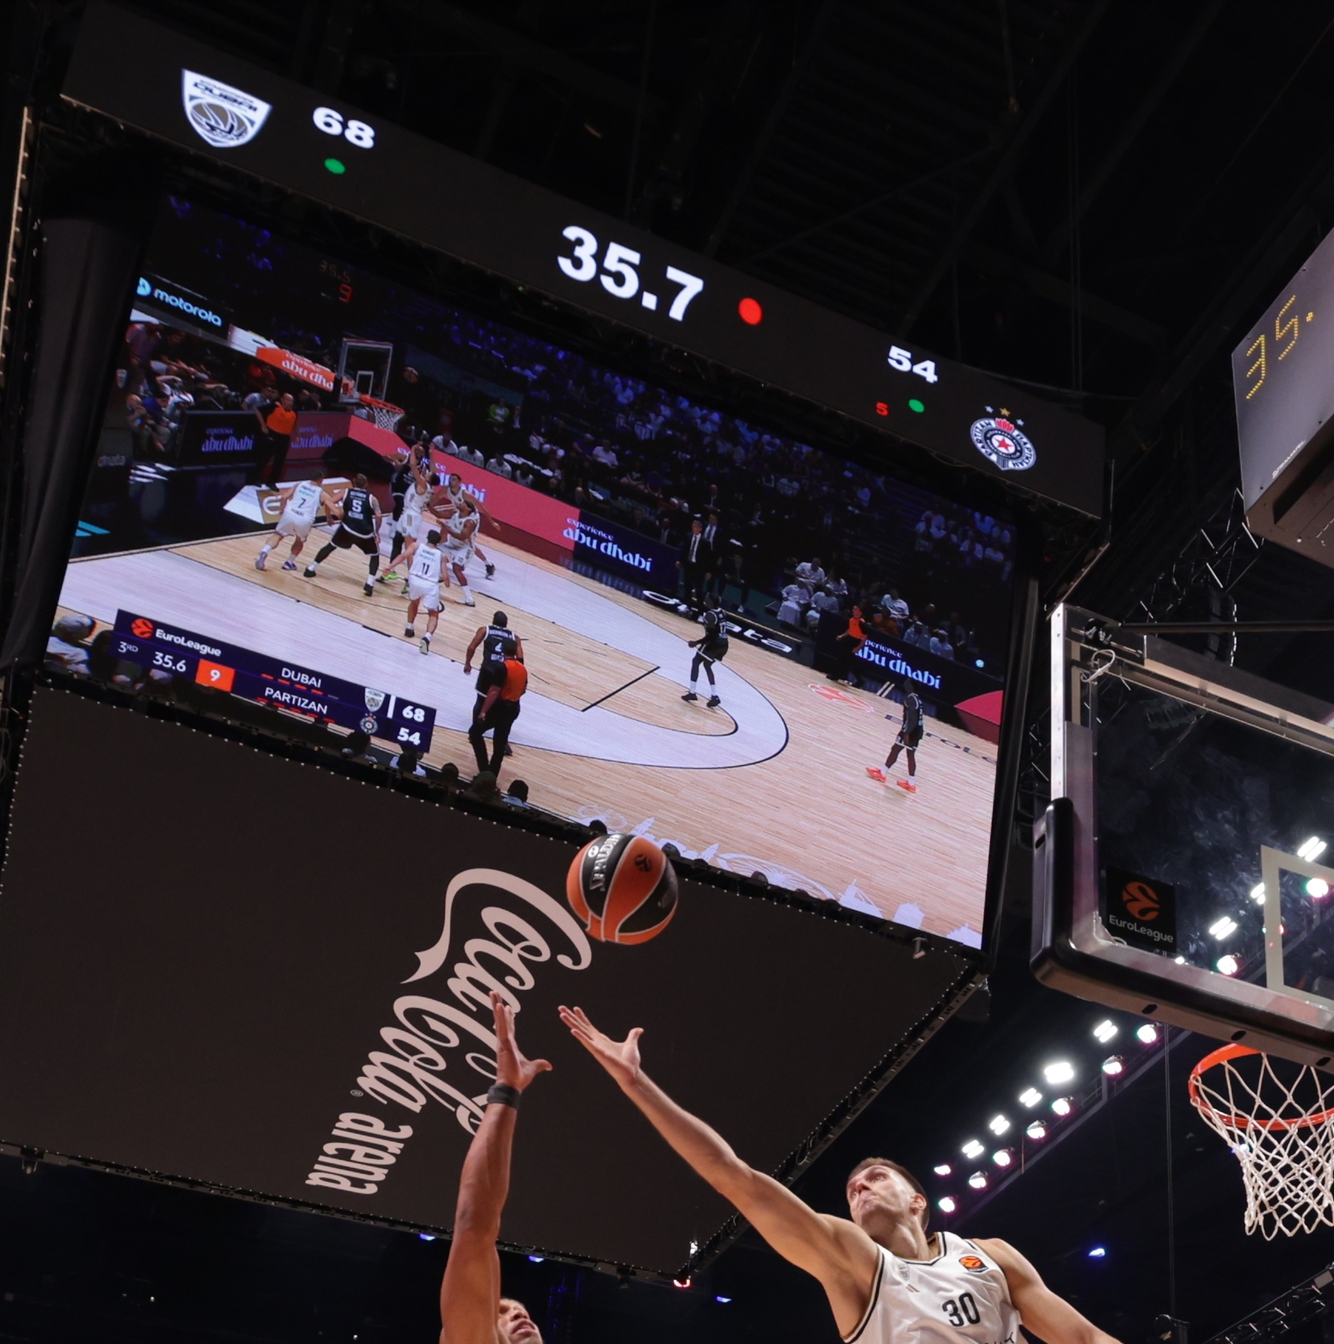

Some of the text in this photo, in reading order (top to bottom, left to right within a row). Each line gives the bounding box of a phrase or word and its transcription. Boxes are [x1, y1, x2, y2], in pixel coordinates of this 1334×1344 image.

[312, 106, 375, 149] 68
[557, 225, 705, 322] 35.7
[153, 288, 222, 327] motorola
[887, 344, 938, 384] 54
[563, 526, 597, 550] abu
[155, 628, 222, 657] EuroLeague
[152, 652, 186, 673] 35.6
[209, 669, 220, 682] 9
[281, 667, 425, 723] DUBAI 68
[264, 687, 420, 746] PARTIZAN 54
[1108, 914, 1174, 943] EuroLeague
[305, 868, 592, 1196] CocaCola arena
[942, 1292, 980, 1327] 30
